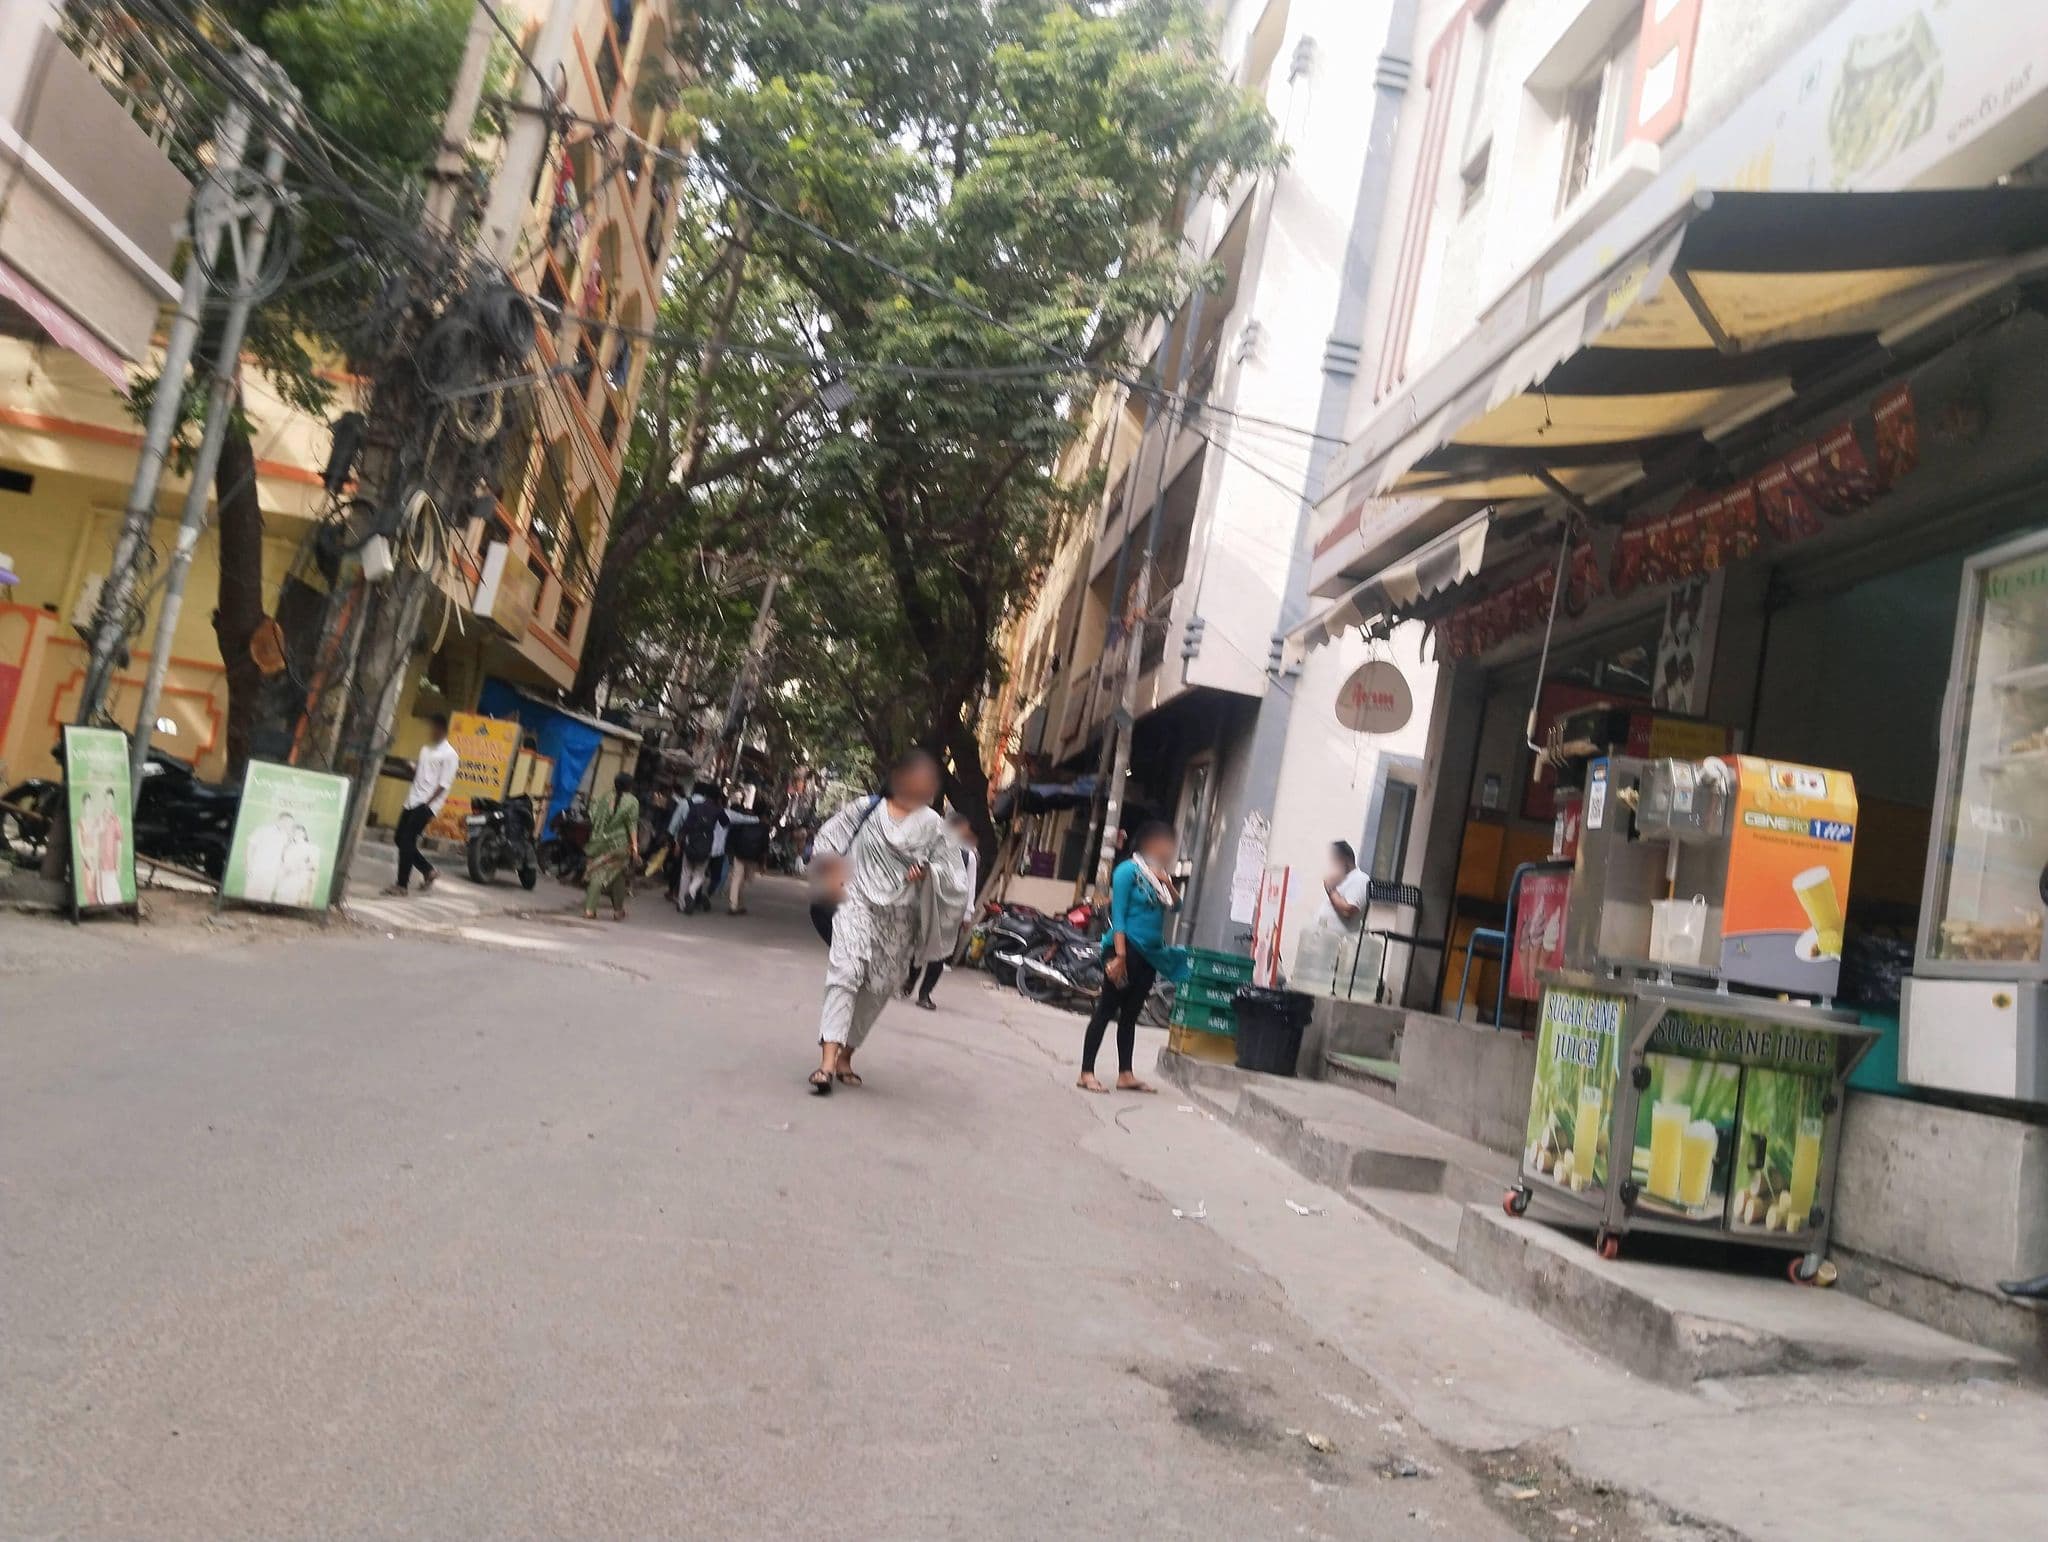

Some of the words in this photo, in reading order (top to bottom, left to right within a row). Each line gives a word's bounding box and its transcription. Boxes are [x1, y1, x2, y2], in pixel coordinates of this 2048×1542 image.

[1547, 994, 1584, 1026] SUGAR
[1585, 999, 1618, 1035] CANE
[1554, 1033, 1598, 1067] JUICE
[1654, 1016, 1772, 1057] SUGARCANE
[1775, 1034, 1828, 1064] JUICE
